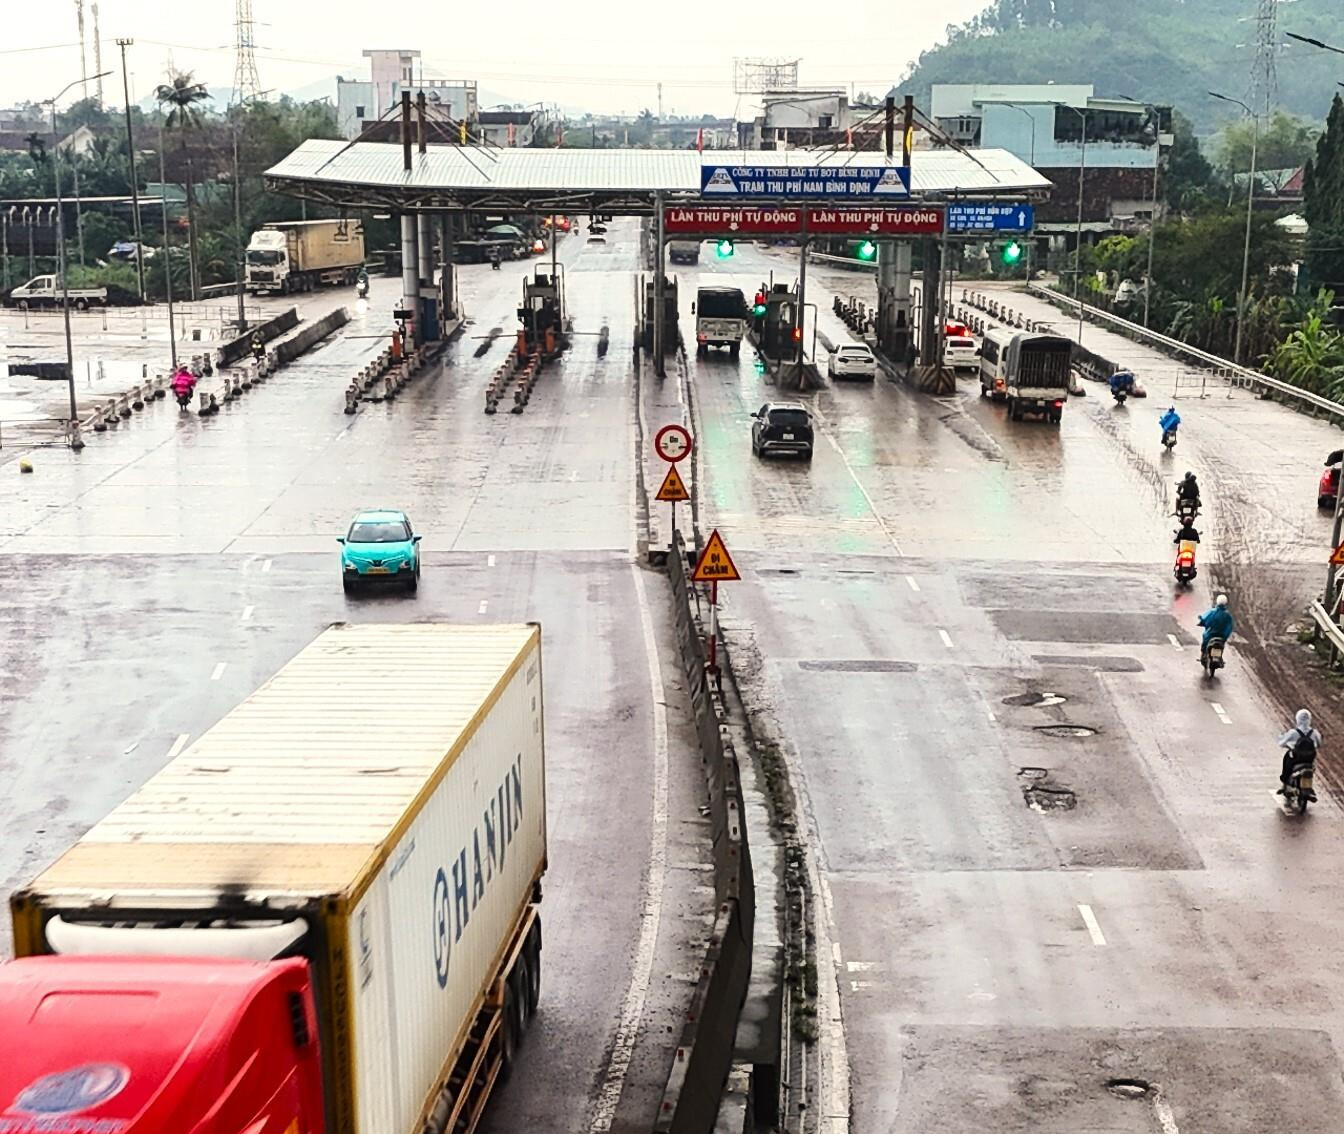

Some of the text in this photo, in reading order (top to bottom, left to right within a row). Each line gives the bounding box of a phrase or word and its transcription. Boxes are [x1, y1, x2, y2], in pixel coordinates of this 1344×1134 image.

[755, 168, 764, 177] TY
[767, 181, 784, 193] THU
[786, 179, 802, 193] PHÍ
[803, 181, 824, 193] NAM
[826, 179, 847, 193] BÌNH
[671, 210, 797, 224] LÀN THU PHÍ TỰ ĐỘNG
[812, 210, 836, 223] LÀN
[838, 212, 862, 223] THU
[864, 211, 884, 223] PHÍ
[886, 212, 903, 225] TỰ
[904, 211, 937, 225] ĐỘNG
[452, 752, 523, 945] HANJIN
